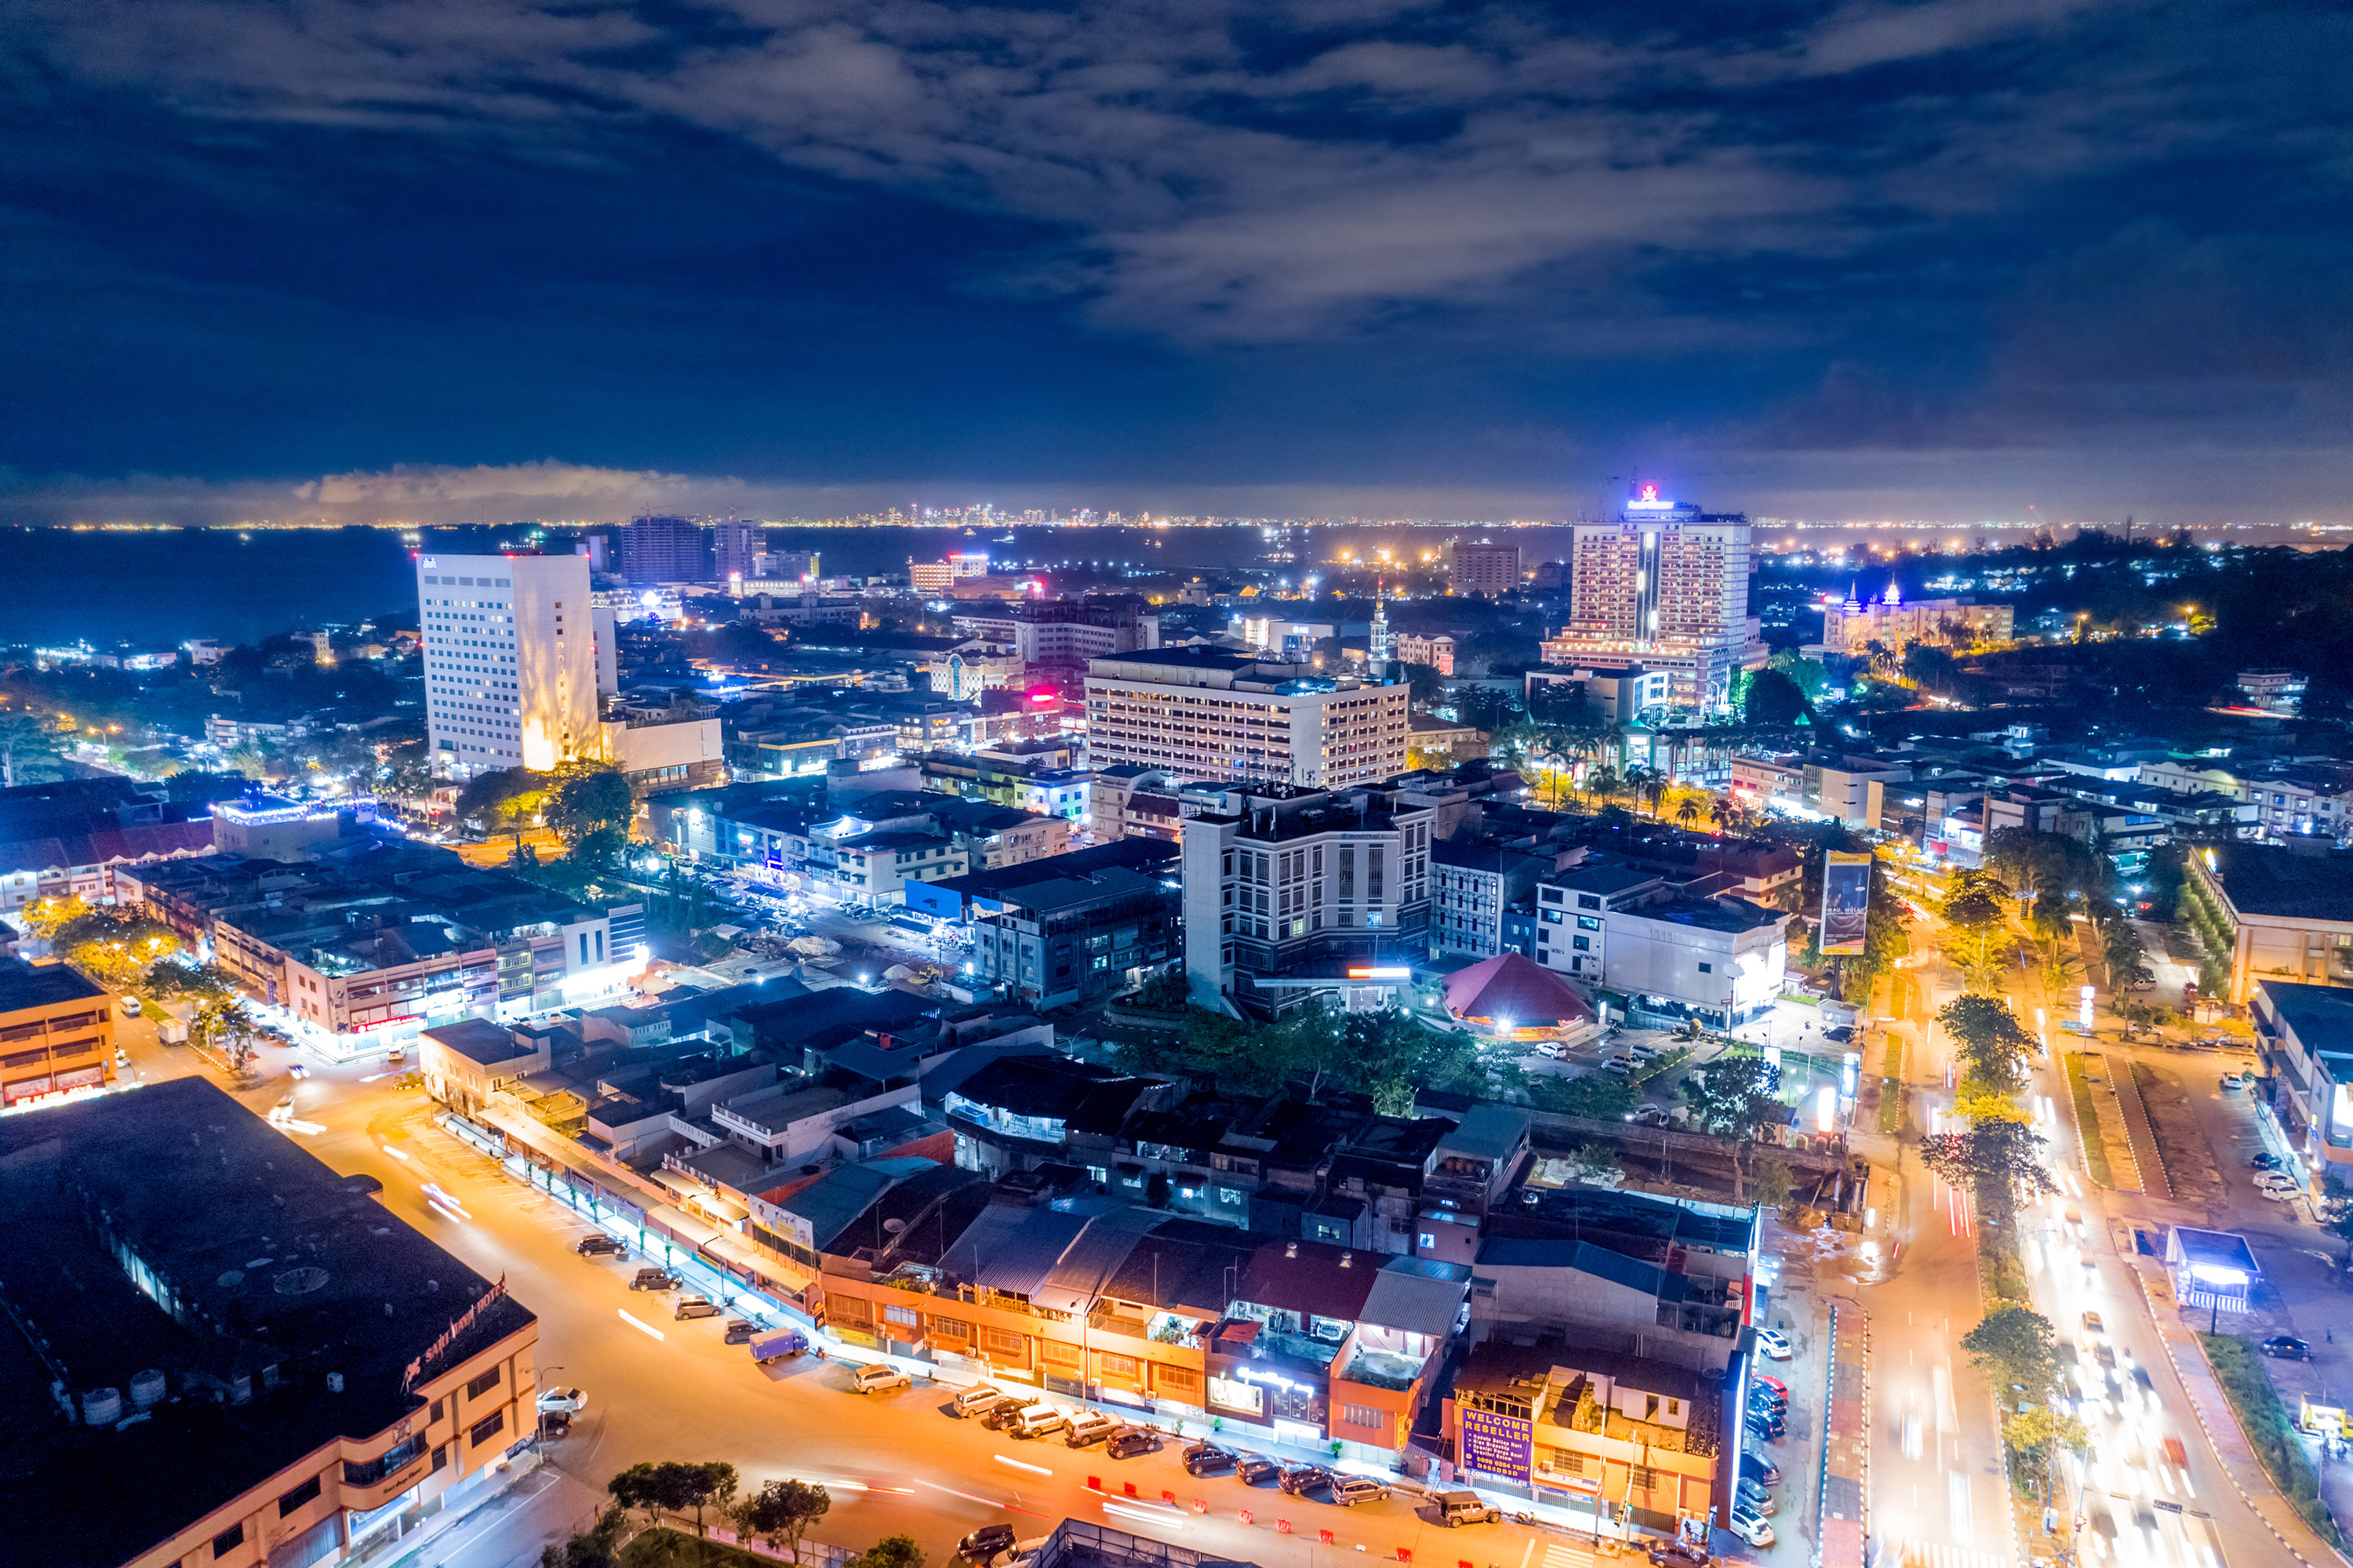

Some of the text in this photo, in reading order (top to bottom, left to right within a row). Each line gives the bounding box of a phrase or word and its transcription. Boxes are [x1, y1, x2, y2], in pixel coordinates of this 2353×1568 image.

[425, 1331, 449, 1362] SARI
[1465, 1421, 1529, 1442] RESELLER
[1466, 1411, 1529, 1432] WELCOME
[1457, 1467, 1492, 1480] WELCOME
[1493, 1474, 1528, 1487] RESELLER
